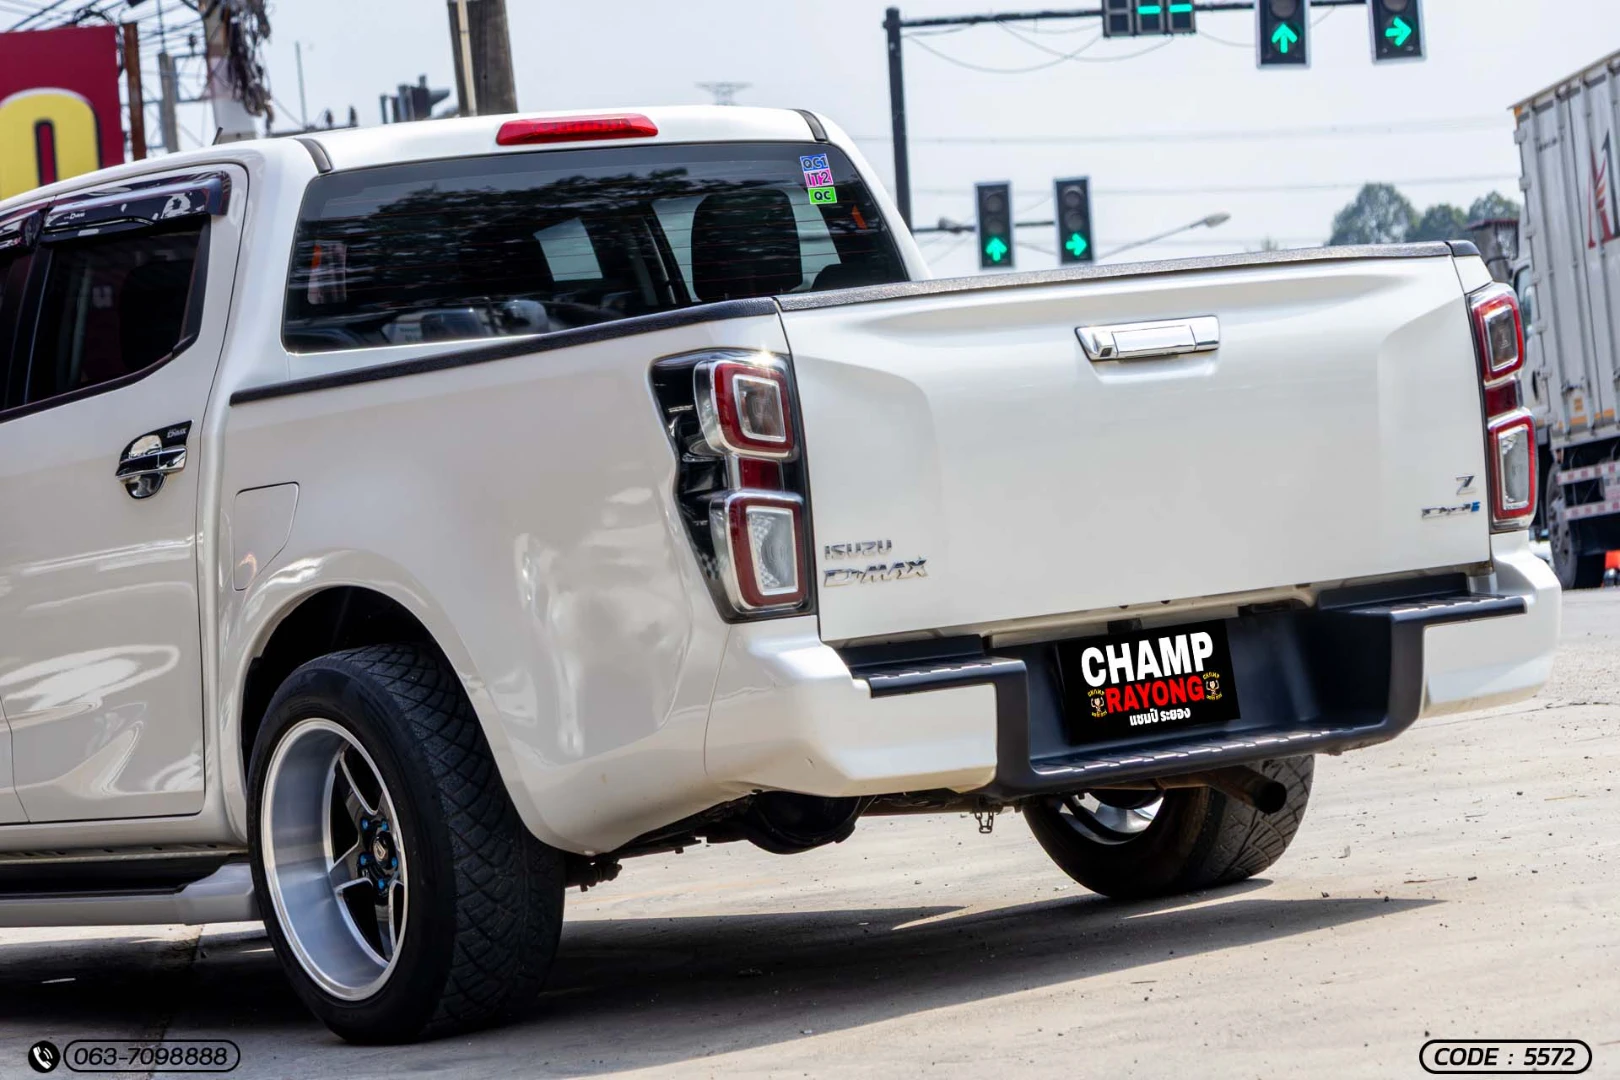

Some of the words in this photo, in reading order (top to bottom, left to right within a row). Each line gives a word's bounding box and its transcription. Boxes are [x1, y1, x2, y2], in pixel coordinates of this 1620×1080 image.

[803, 156, 828, 169] QC1
[814, 191, 832, 200] QC
[824, 540, 892, 560] ISUZU
[1081, 631, 1213, 687] CHAMP
[1105, 675, 1205, 714] RAYONG
[1160, 707, 1191, 722] ระยอง
